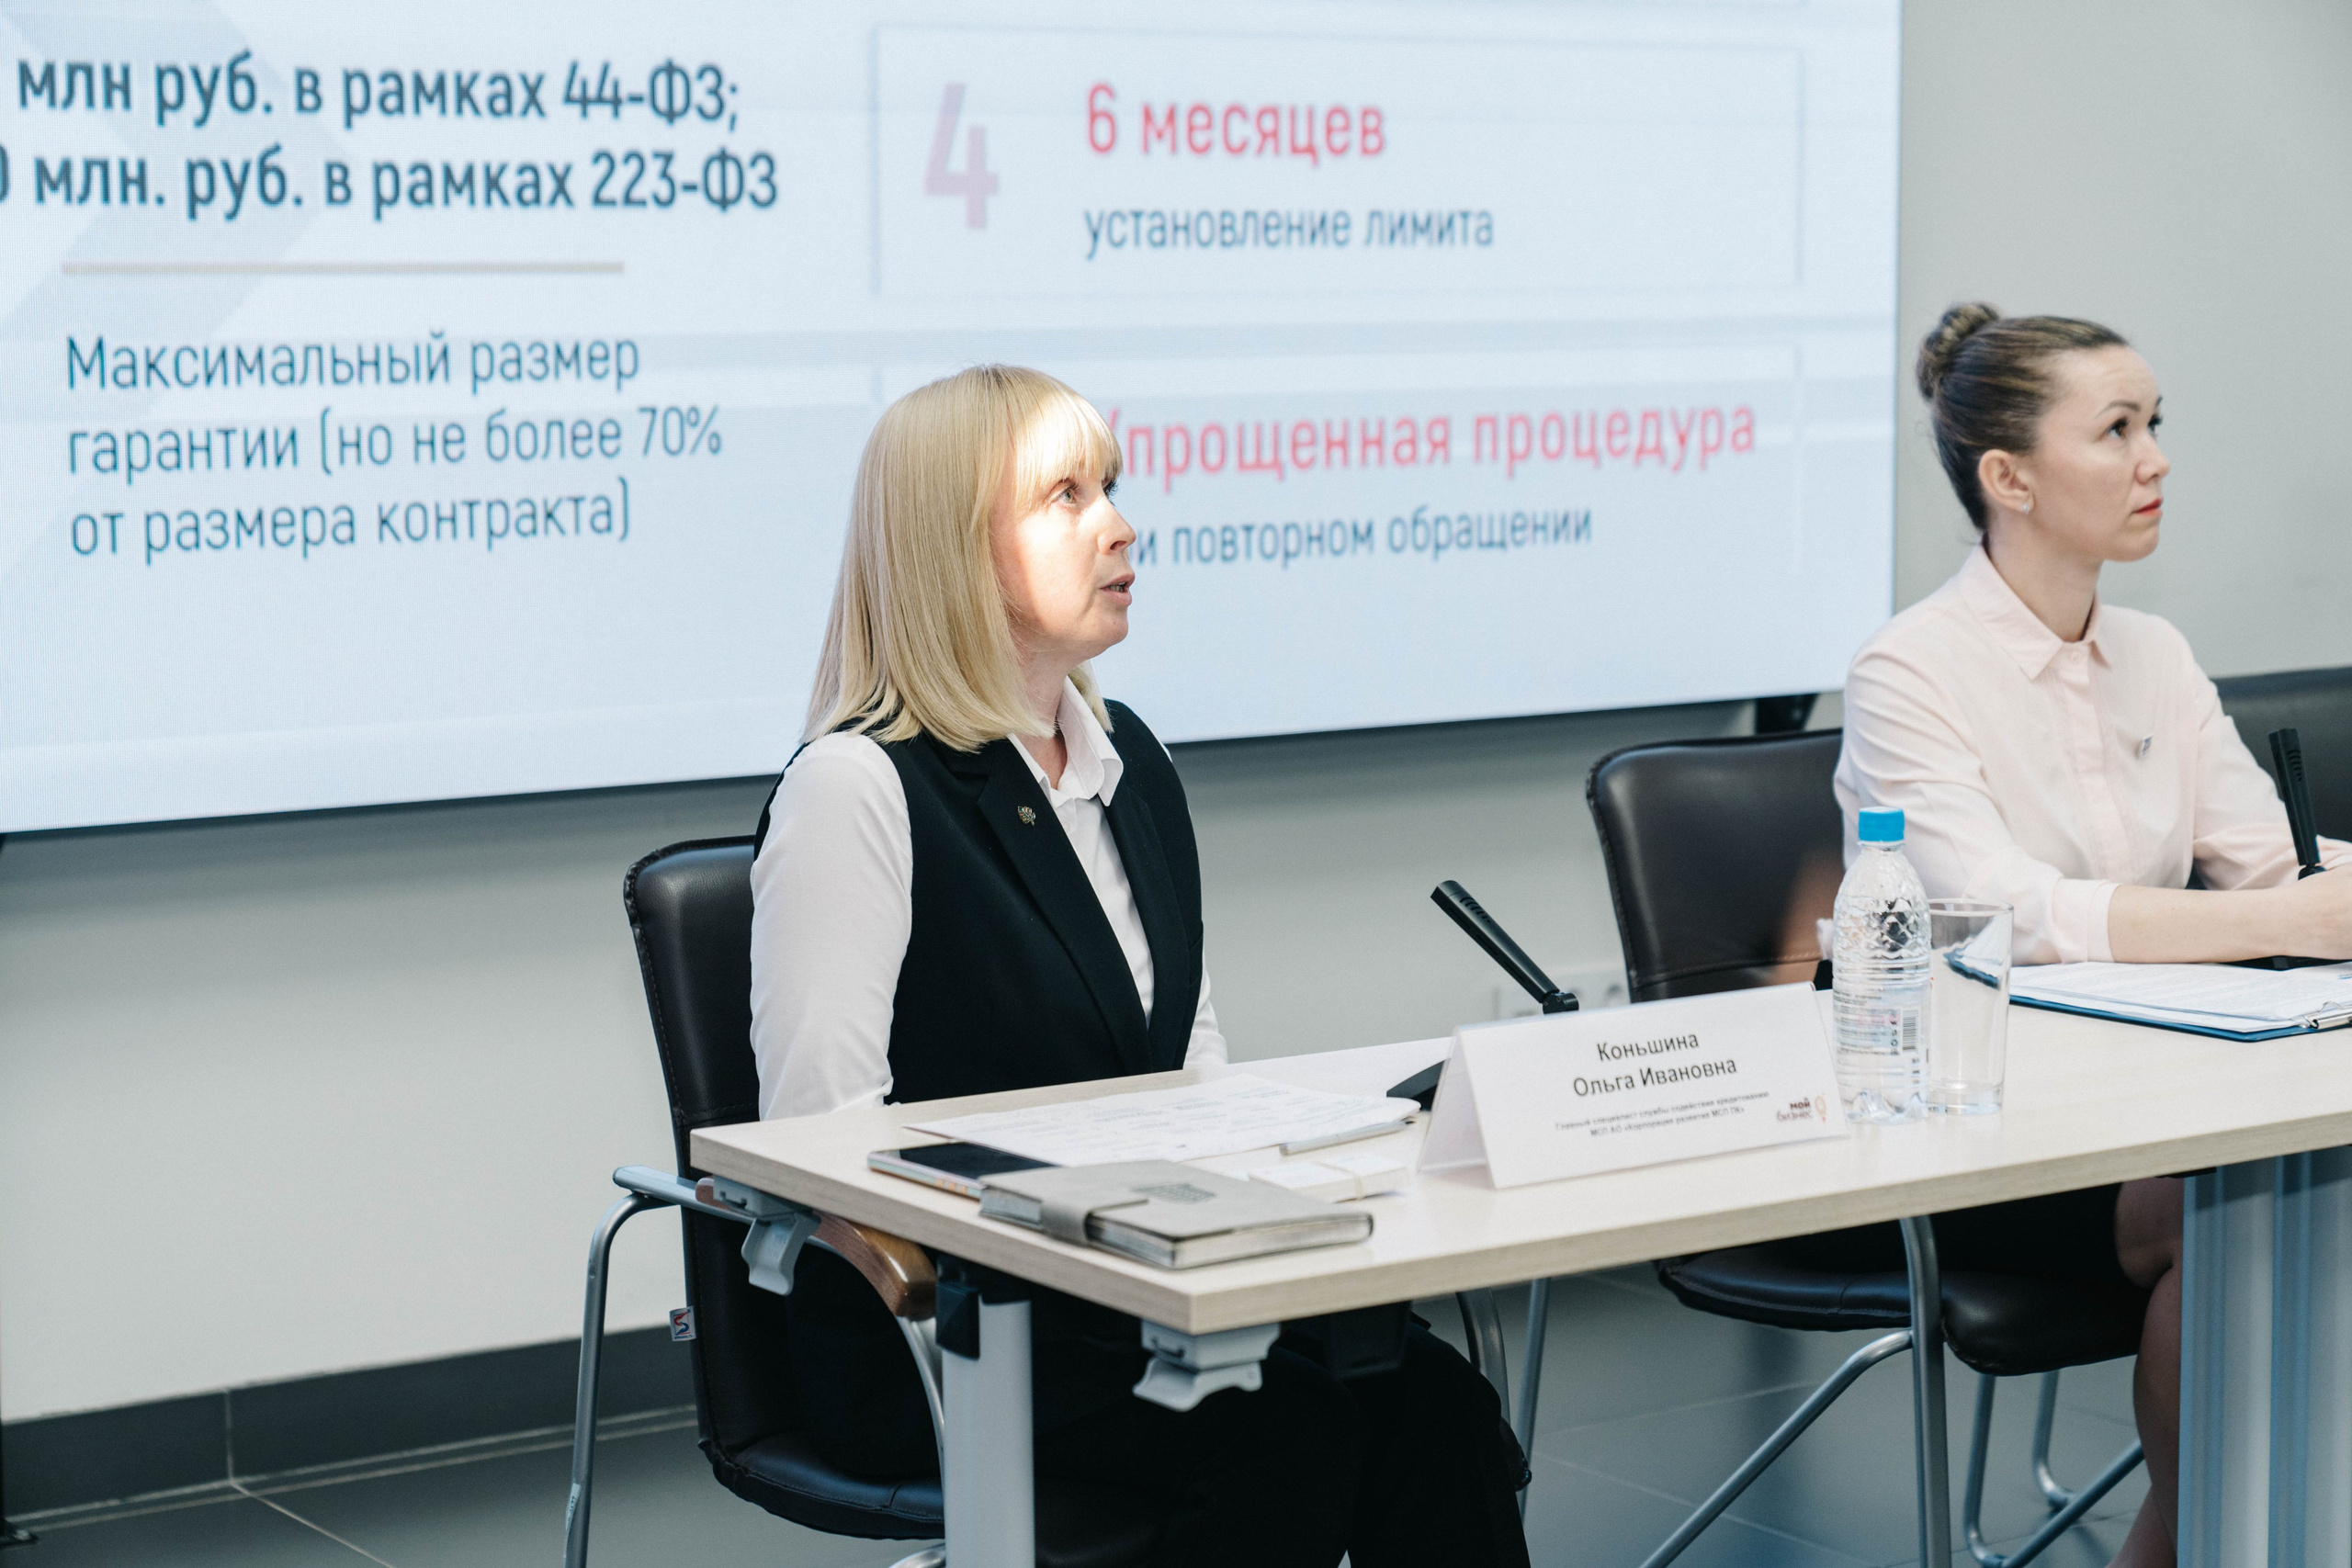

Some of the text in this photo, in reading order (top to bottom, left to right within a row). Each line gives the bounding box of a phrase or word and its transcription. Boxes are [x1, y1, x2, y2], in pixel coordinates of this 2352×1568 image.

[16, 58, 132, 114] млн
[153, 46, 275, 130] руб.
[293, 65, 325, 117] в
[341, 67, 548, 132] рамках
[1086, 80, 1386, 167] 6 месяцев
[33, 154, 166, 209] млн.
[185, 140, 305, 224] руб.
[322, 159, 354, 209] в
[370, 159, 577, 224] рамках
[923, 82, 1001, 231] 4
[1083, 209, 1494, 261] установление лимита
[66, 329, 640, 397] Максимальный размер
[68, 404, 723, 487] гарантии (но не более 70%
[1472, 405, 1756, 481] процедура
[71, 474, 630, 568] от размера контракта)
[1172, 519, 1375, 570] повторном
[1386, 504, 1592, 561] обращении
[1573, 1059, 1737, 1097] Ольга Ивановна
[1596, 1032, 1700, 1062] Коньшина
